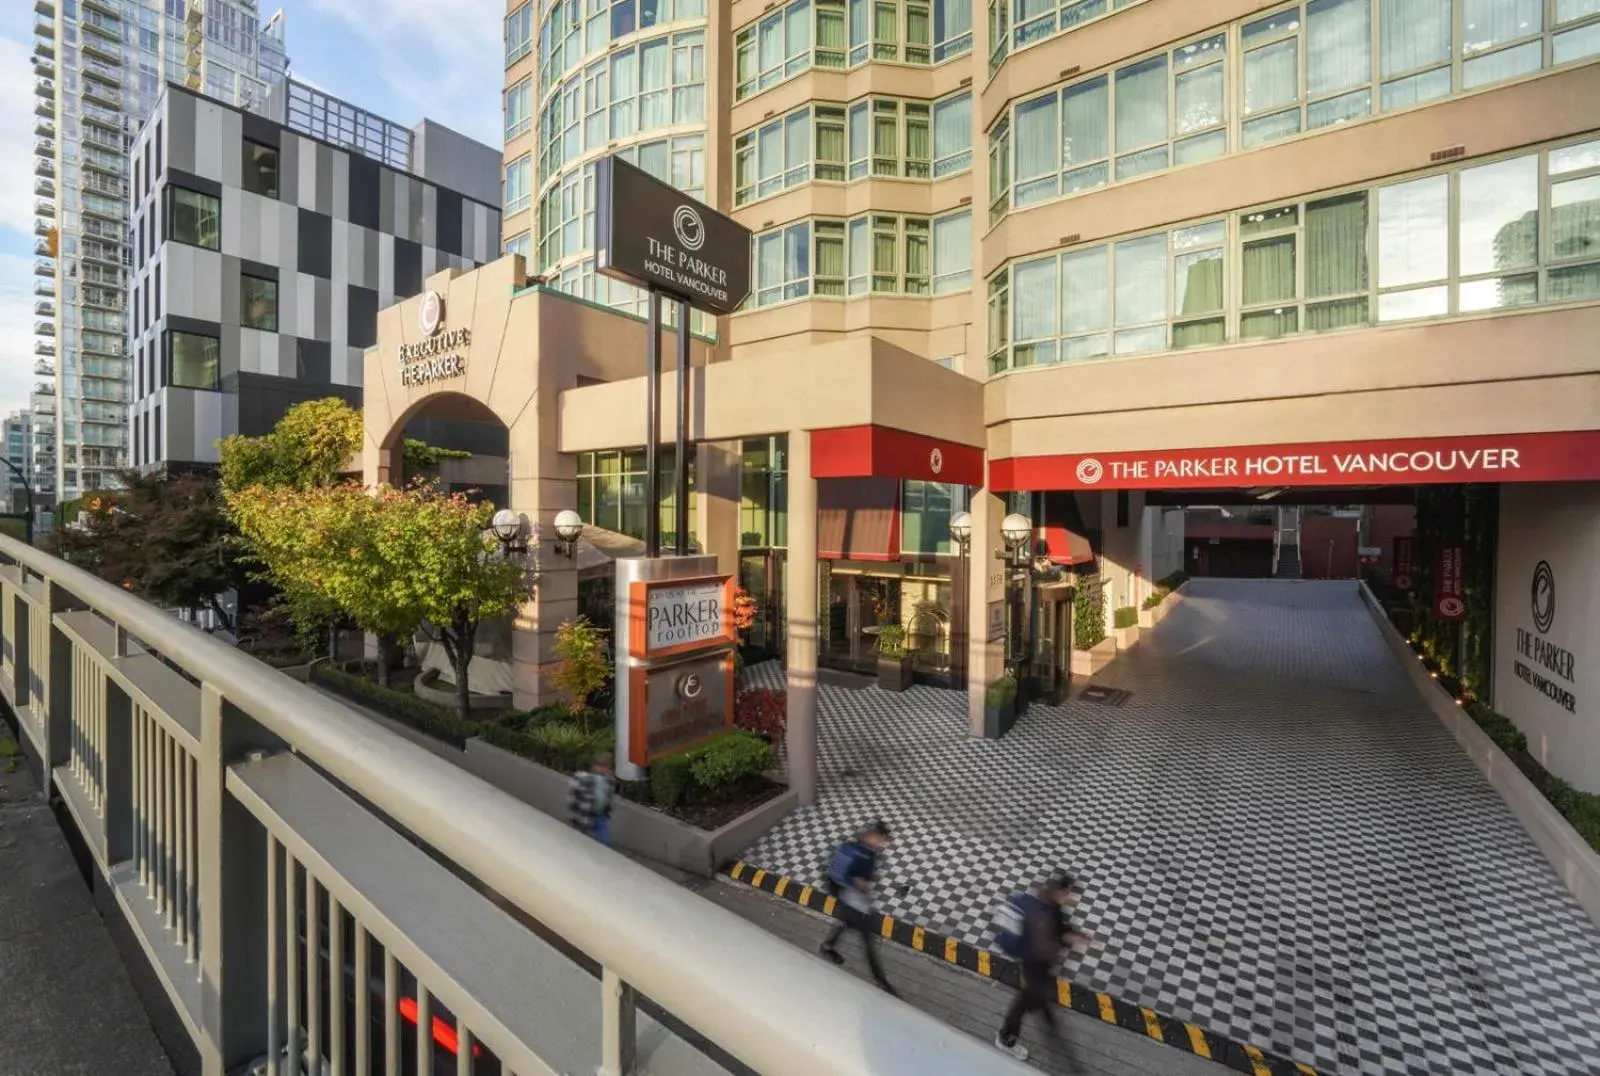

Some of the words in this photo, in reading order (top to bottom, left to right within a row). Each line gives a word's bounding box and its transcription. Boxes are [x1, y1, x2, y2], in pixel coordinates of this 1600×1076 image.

[645, 236, 676, 265] THE
[678, 251, 728, 288] PARKER
[644, 259, 676, 282] HOTEL
[676, 272, 728, 302] VANCOUVER
[398, 328, 468, 363] EXECUTIVE
[418, 354, 462, 382] PARKER
[1108, 460, 1149, 479] THE
[1154, 457, 1239, 478] PARKER
[1245, 454, 1328, 476] HOTEL
[1332, 448, 1521, 474] VANCOUVER
[649, 598, 720, 631] PARKER
[657, 622, 721, 643] rooftop
[1516, 627, 1534, 660] THE
[1534, 636, 1576, 684] PARKER
[1513, 659, 1533, 686] HOTEL
[1532, 671, 1577, 715] VANCOUVER
